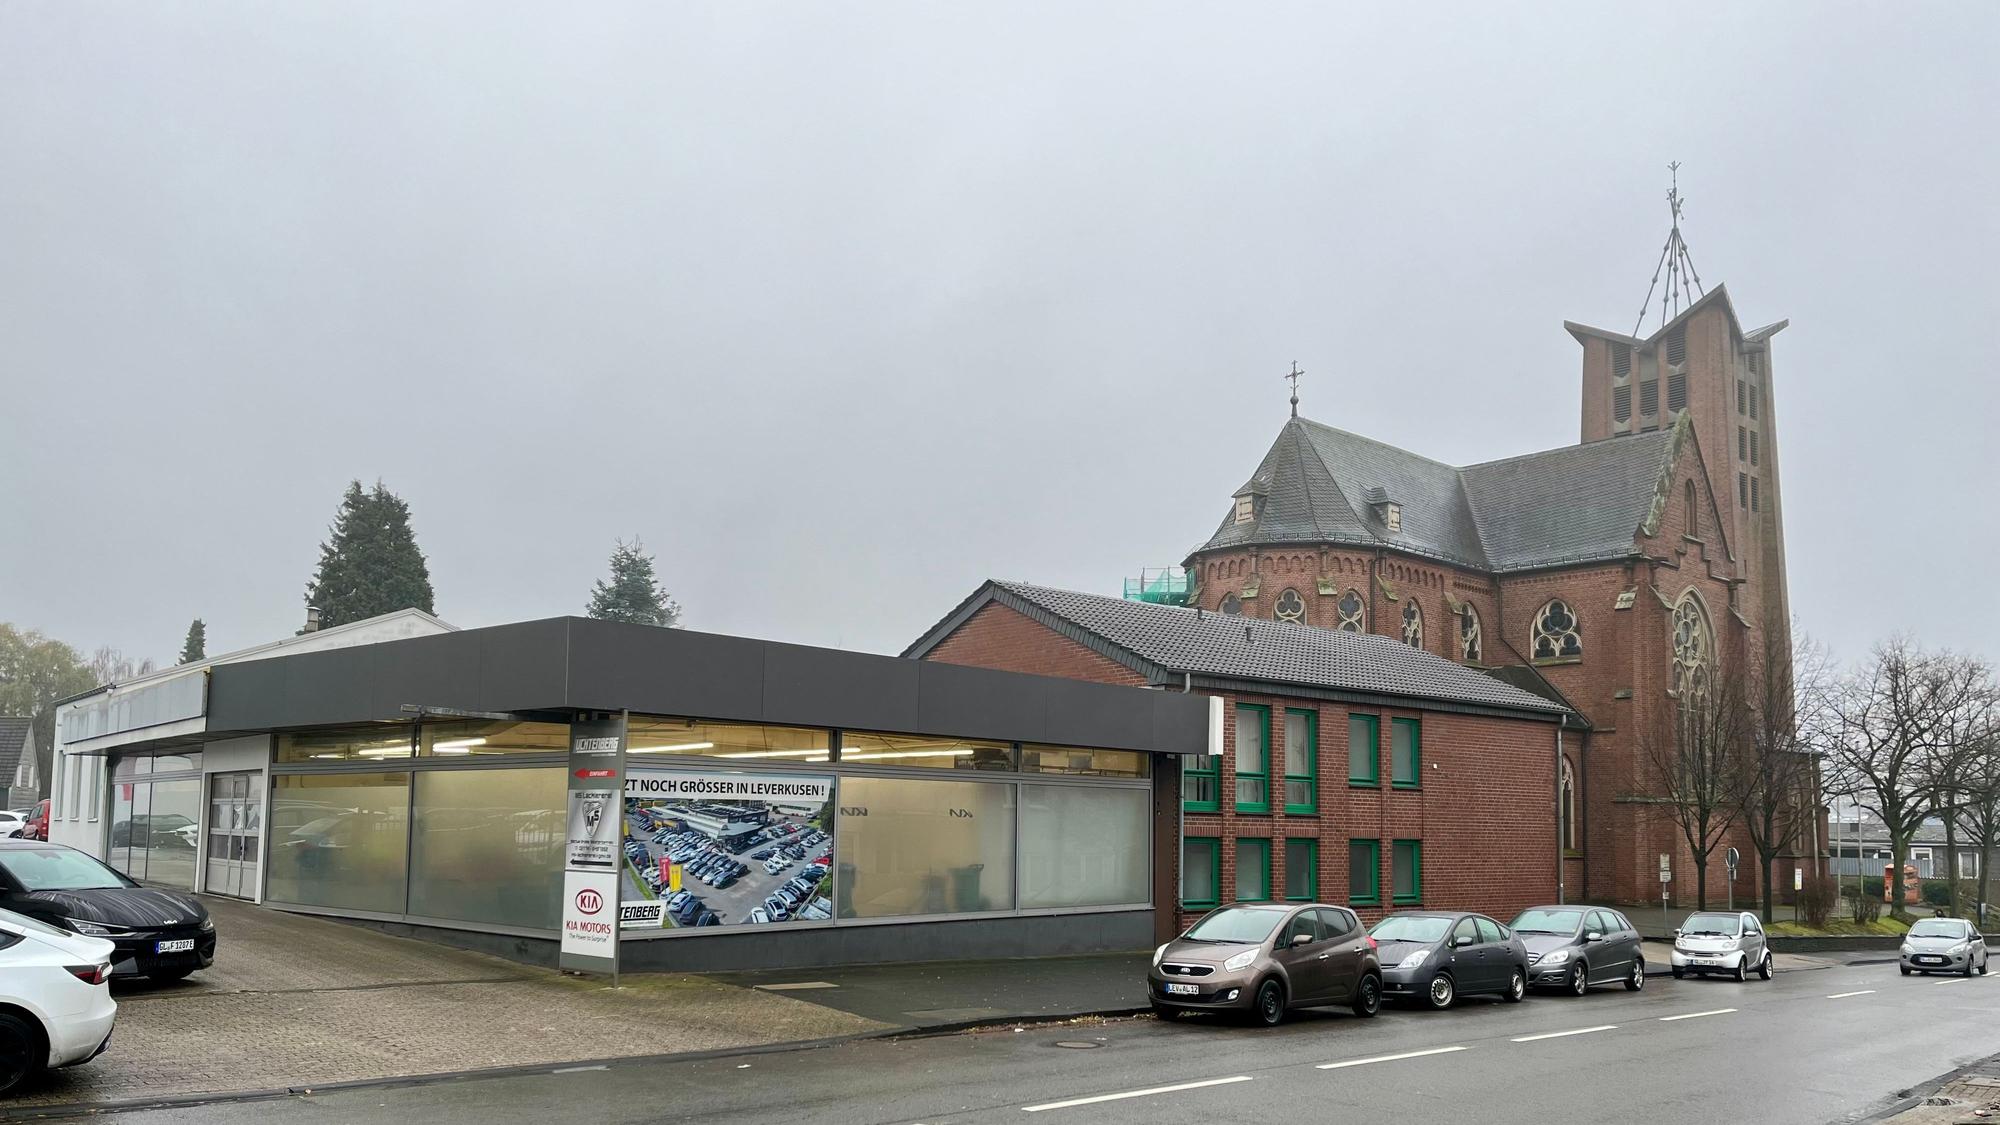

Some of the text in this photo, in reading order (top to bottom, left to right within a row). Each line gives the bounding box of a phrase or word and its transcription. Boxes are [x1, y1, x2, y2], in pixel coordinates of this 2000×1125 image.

[641, 779, 677, 792] NOCH
[680, 778, 734, 794] GRÖSSER
[736, 782, 748, 794] IN
[751, 783, 819, 796] LEVERKUSEN
[821, 785, 825, 796] !
[580, 895, 598, 909] KIA
[566, 920, 578, 931] KIA
[580, 921, 611, 934] MOTORS
